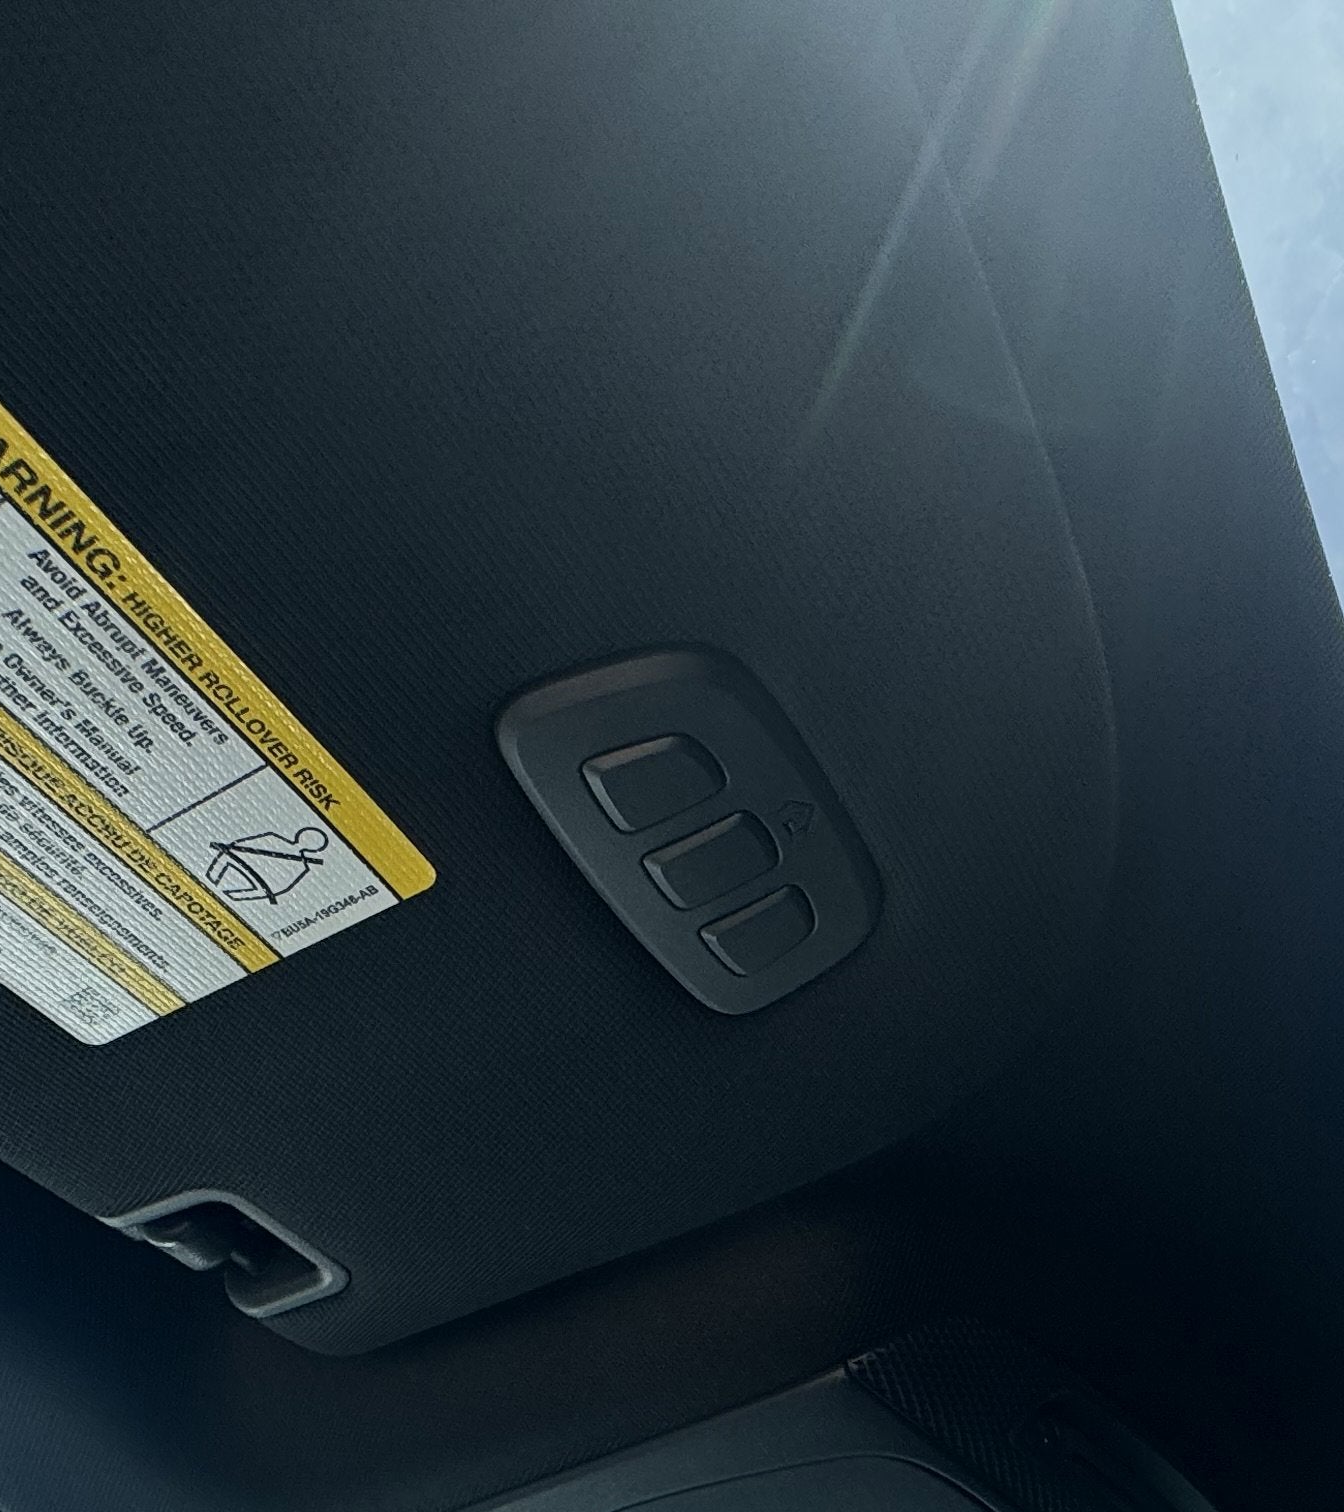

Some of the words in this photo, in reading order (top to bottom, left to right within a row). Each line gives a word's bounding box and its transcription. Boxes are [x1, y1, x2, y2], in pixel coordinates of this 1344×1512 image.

[0, 651, 81, 722] Owner's
[72, 717, 142, 777] Manual
[18, 573, 64, 613] and
[56, 609, 148, 694] Excessive
[136, 691, 202, 749] Speed.
[26, 544, 88, 602] Avoid
[76, 597, 147, 662] Abrupt
[139, 657, 232, 746] Maneuvers
[66, 668, 134, 728] Buckle
[122, 723, 162, 756] Up.
[120, 590, 206, 672] HIGHER
[196, 669, 301, 771] ROLLOVER
[292, 767, 341, 811] RISK
[30, 709, 133, 798] Information
[15, 793, 89, 853] vitesses
[81, 849, 170, 921] excessives.
[57, 788, 133, 850] ACCRU
[124, 847, 160, 874] DE
[150, 871, 247, 951] CAPOTAGE
